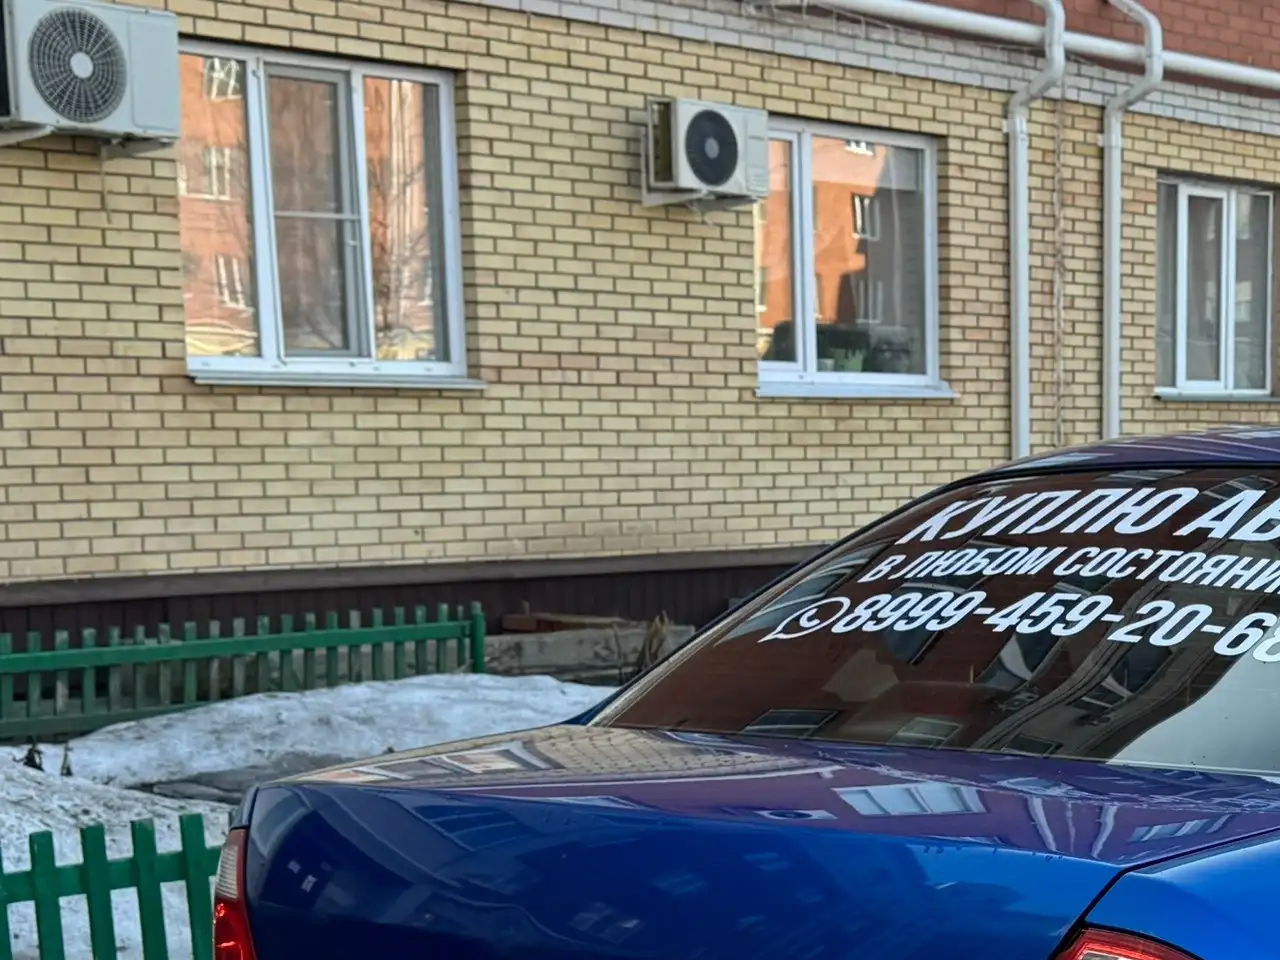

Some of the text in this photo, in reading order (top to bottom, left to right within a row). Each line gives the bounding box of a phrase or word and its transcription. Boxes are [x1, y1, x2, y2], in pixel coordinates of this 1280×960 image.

[895, 487, 1199, 545] КУПЛЮ
[857, 554, 906, 584] В
[889, 546, 1068, 579] ЛЮБОМ
